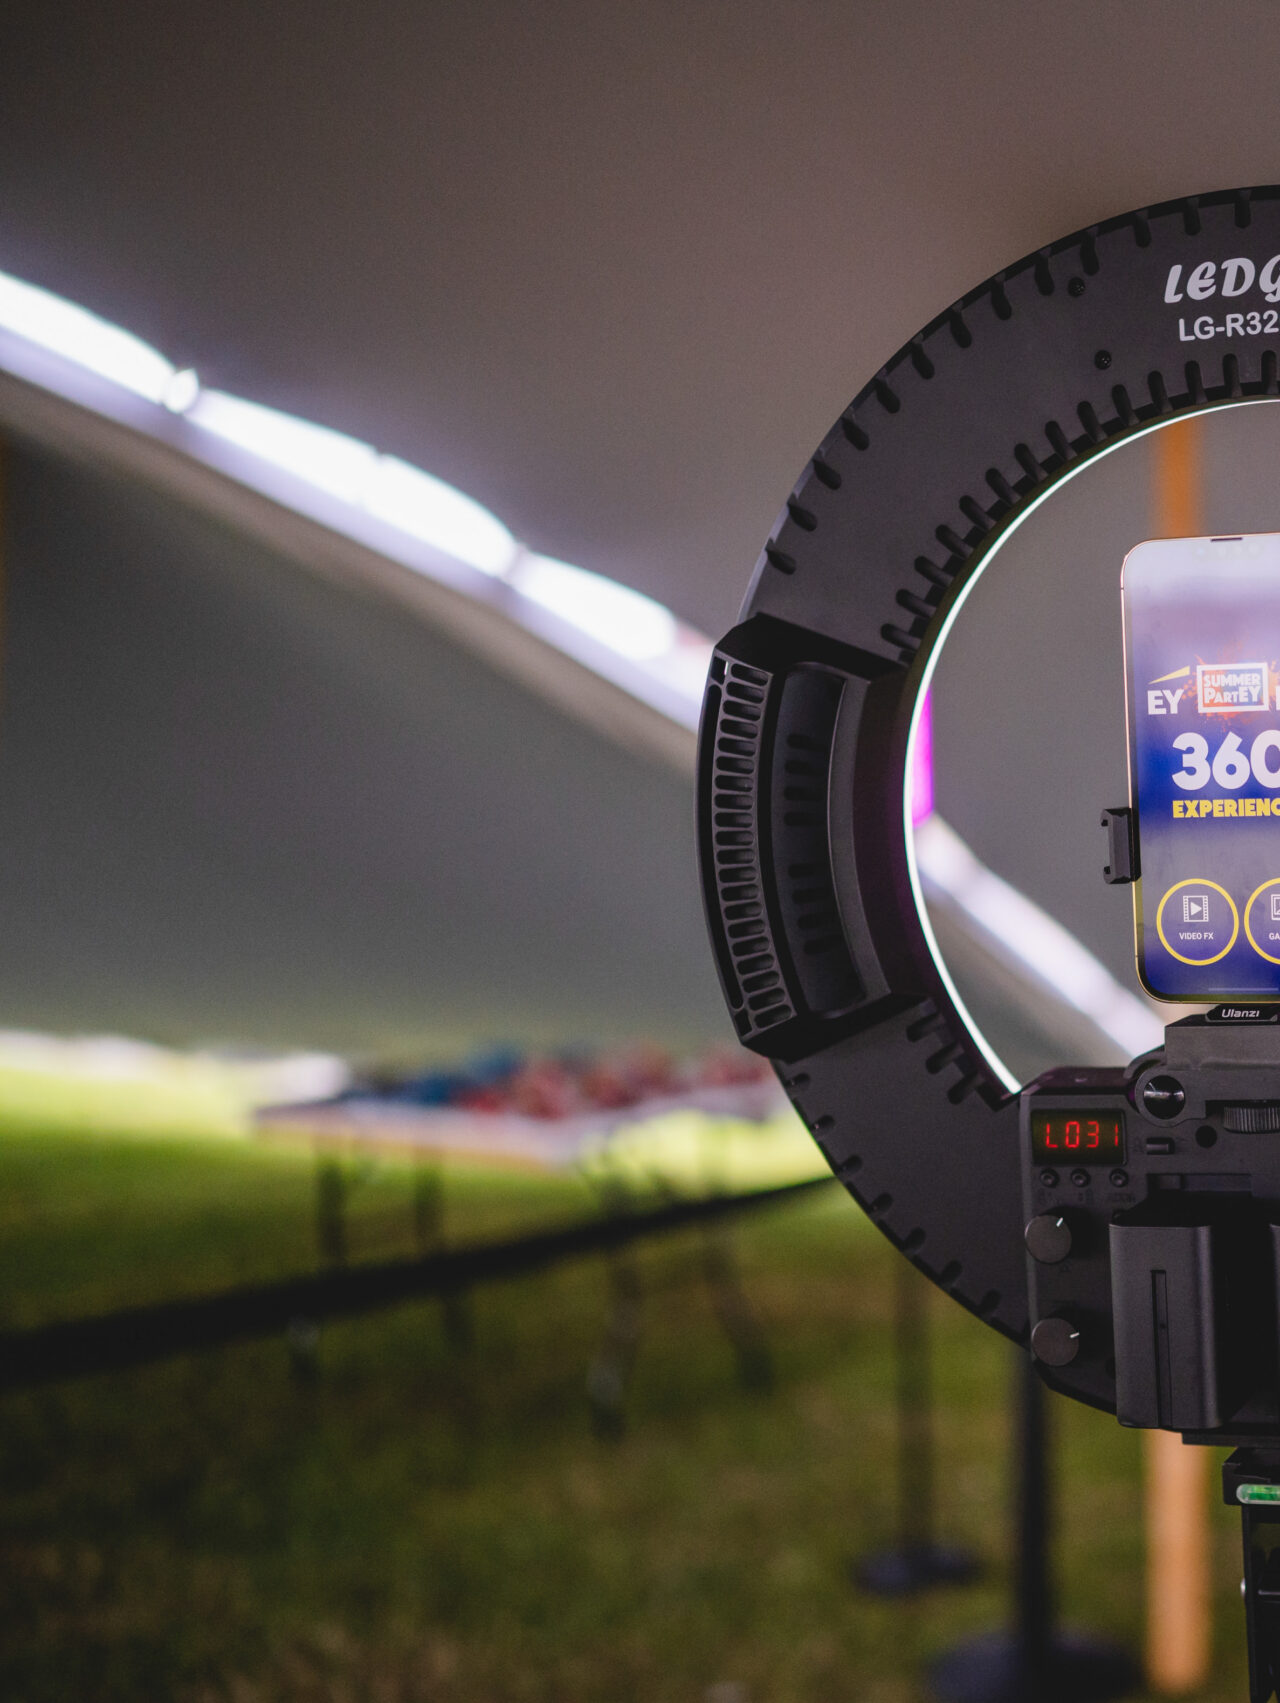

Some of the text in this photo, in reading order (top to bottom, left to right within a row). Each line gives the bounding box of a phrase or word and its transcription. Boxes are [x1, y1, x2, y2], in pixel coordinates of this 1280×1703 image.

[1203, 673, 1261, 687] SUMMER
[1147, 689, 1184, 715] EY
[1179, 932, 1214, 940] VIDEO FX
[1221, 1008, 1260, 1018] Ulanzi
